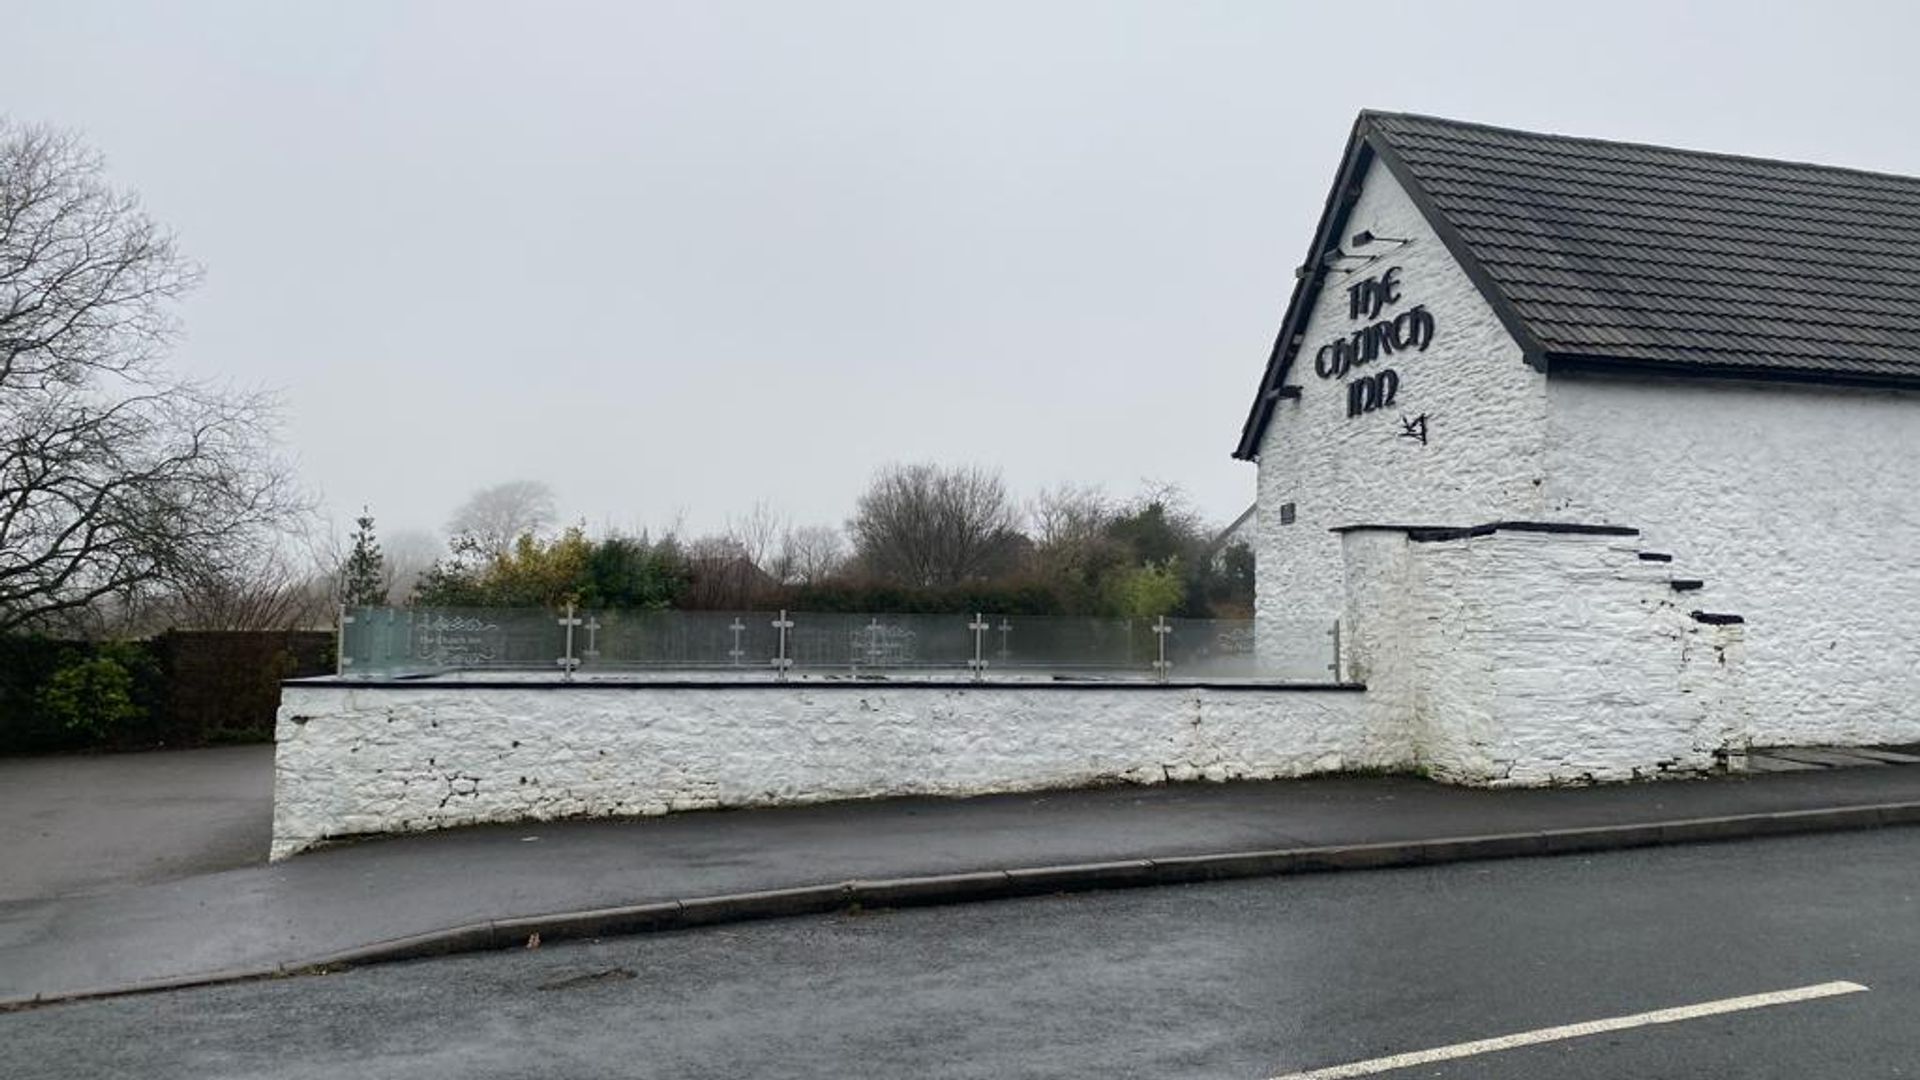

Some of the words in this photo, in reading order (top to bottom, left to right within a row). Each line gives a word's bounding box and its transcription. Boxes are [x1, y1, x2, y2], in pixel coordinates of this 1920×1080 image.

[1347, 266, 1402, 320] THE
[1316, 304, 1435, 379] CHURCH
[1347, 369, 1399, 418] INN
